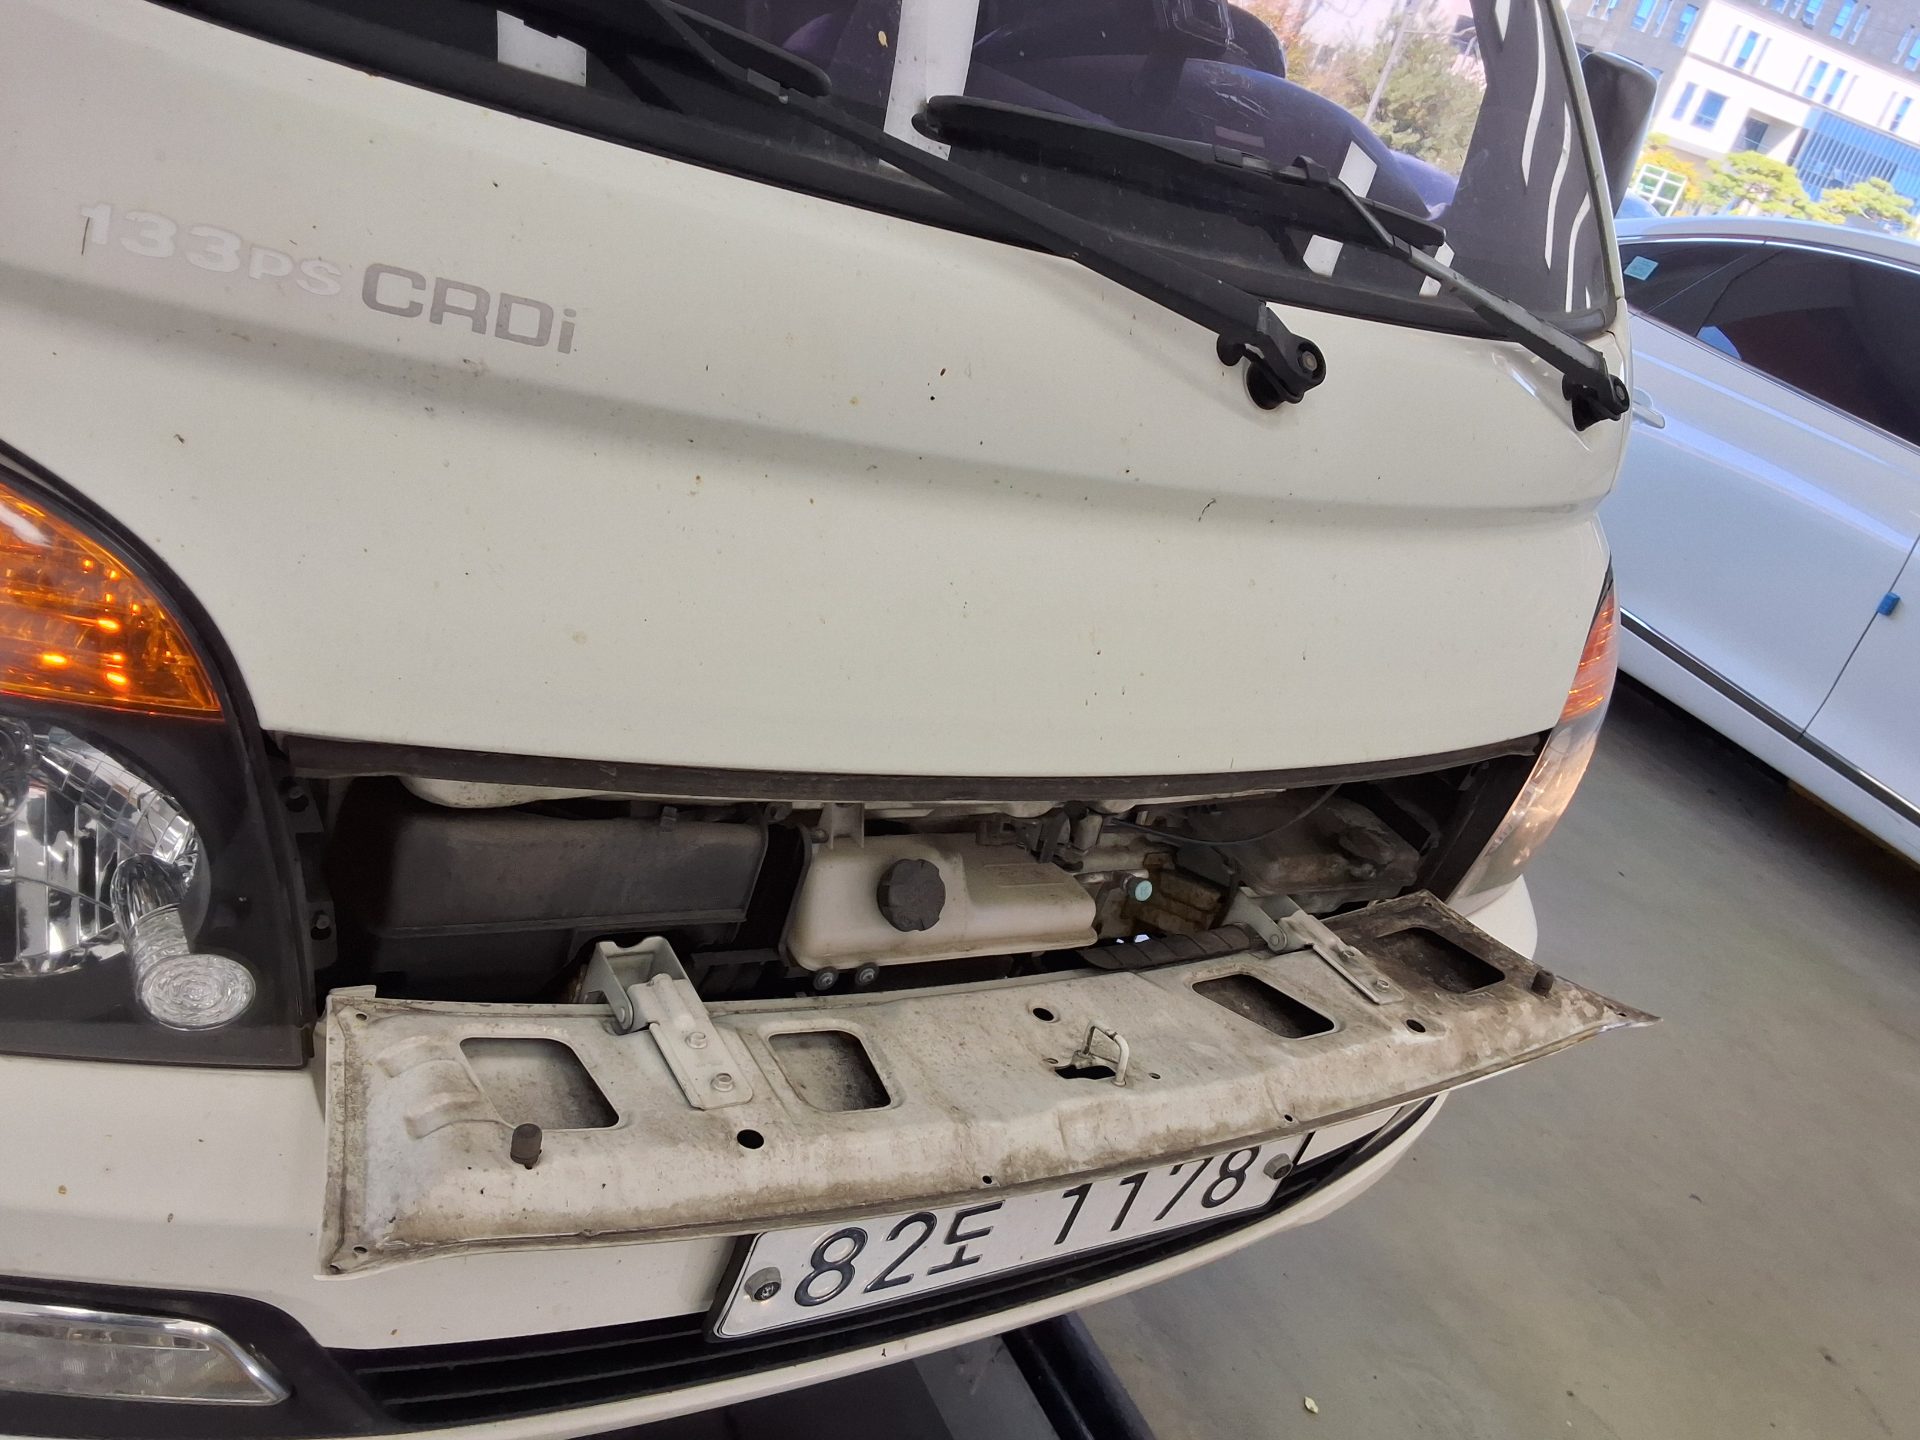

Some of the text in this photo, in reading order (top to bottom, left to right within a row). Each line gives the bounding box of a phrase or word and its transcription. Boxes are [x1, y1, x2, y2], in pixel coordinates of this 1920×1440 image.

[362, 262, 577, 354] CRDi
[794, 1145, 1262, 1307] 82도 1178
